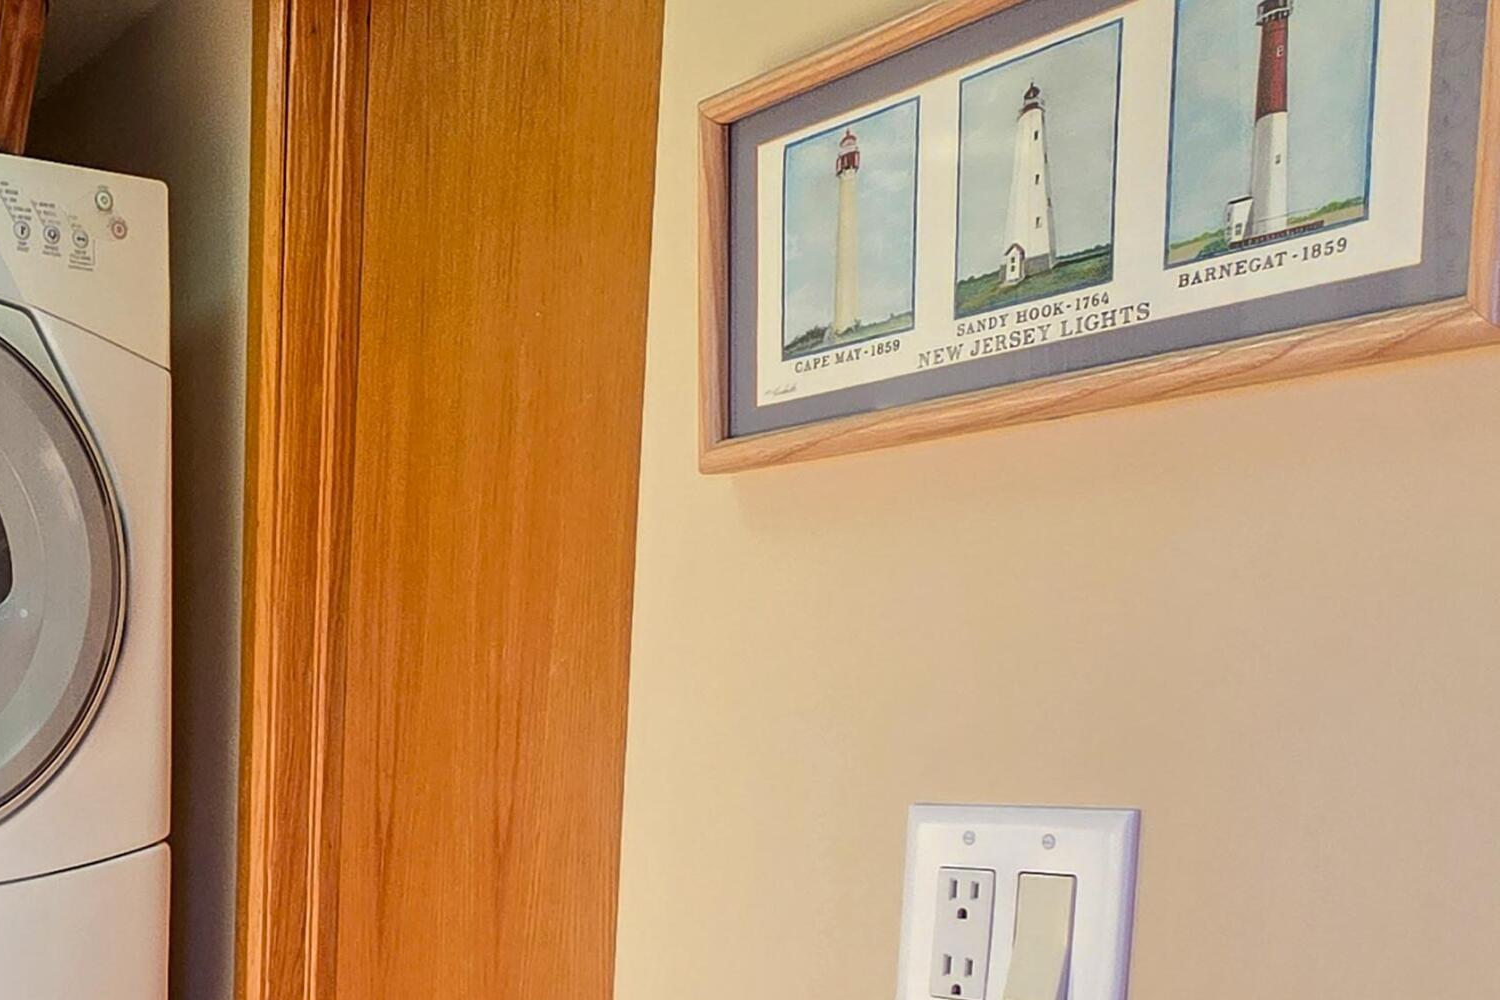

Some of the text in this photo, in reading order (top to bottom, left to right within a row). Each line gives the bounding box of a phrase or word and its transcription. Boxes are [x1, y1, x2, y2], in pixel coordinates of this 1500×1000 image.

[917, 301, 1151, 369] NEW JERSEY LIGHTS
[956, 313, 1009, 337] SANDY
[794, 354, 832, 374] CAPE
